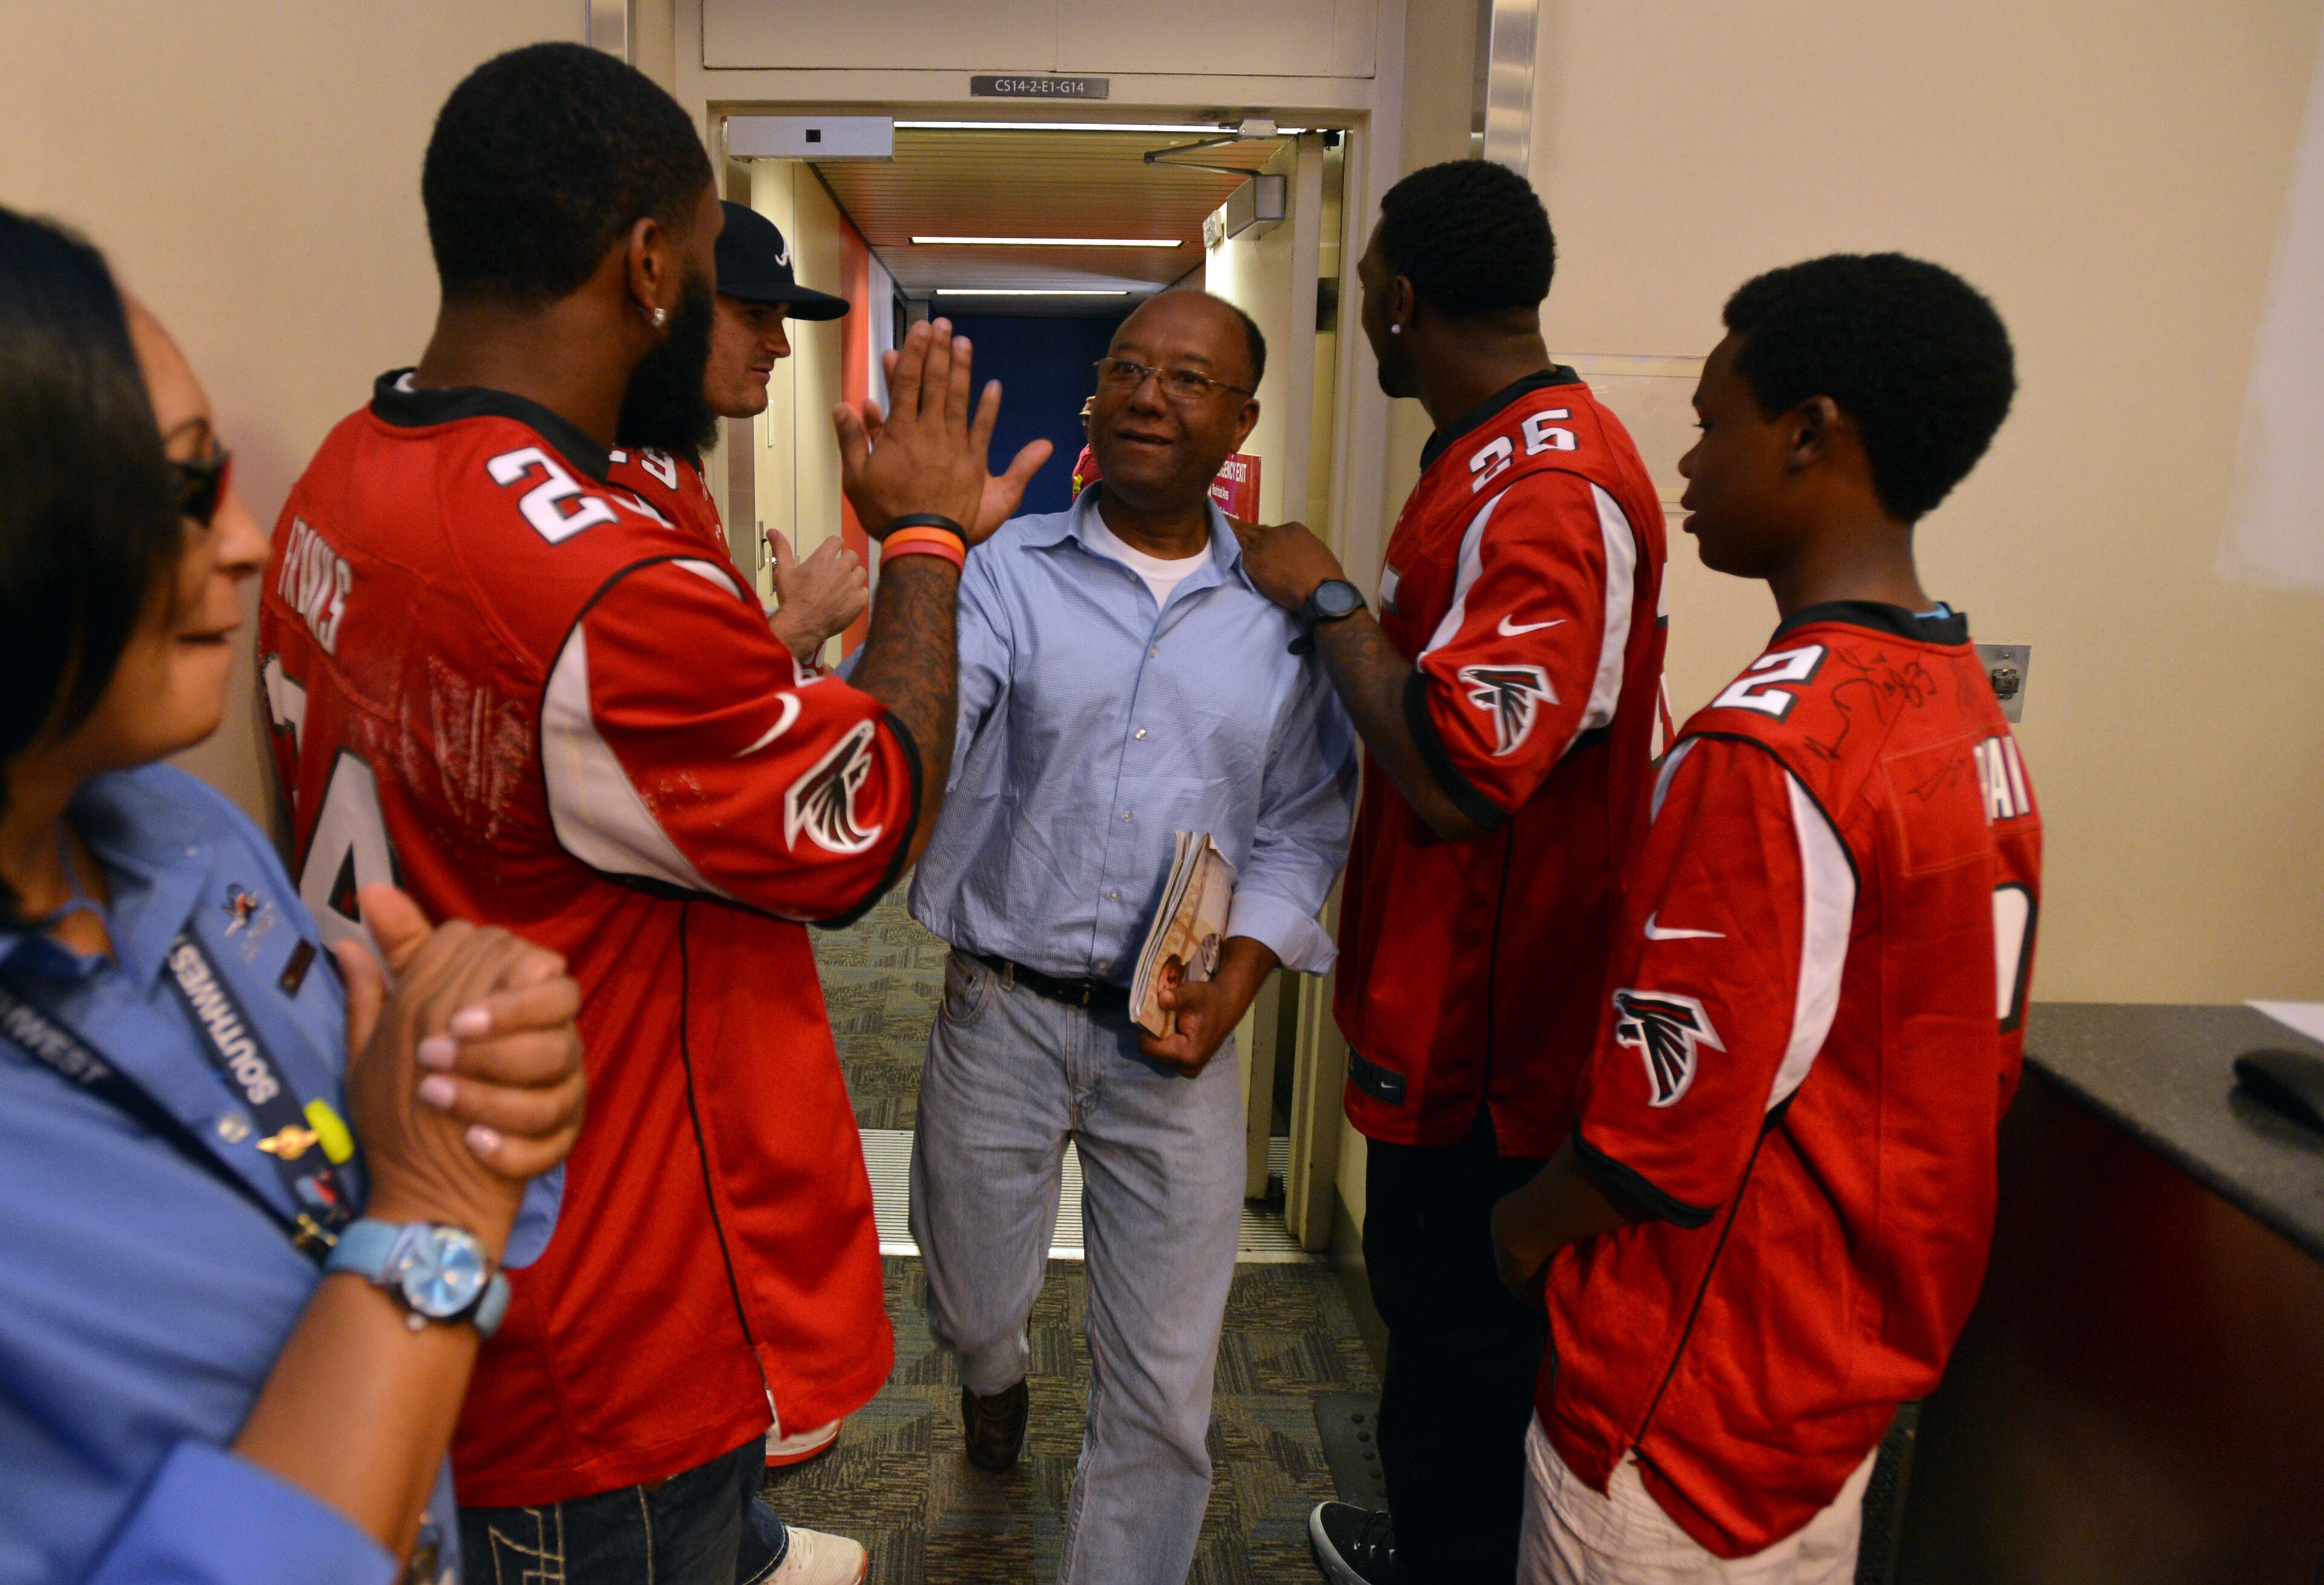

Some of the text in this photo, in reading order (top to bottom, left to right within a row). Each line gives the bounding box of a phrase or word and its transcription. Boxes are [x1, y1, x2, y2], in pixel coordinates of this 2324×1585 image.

[995, 79, 1085, 93] CS14-2-E1-G14
[486, 446, 623, 545] 2
[1216, 460, 1247, 483] GENCY EXIT
[1710, 643, 1829, 724] 2
[0, 993, 110, 1085] WEST
[169, 938, 281, 1105] SOUTHWES
